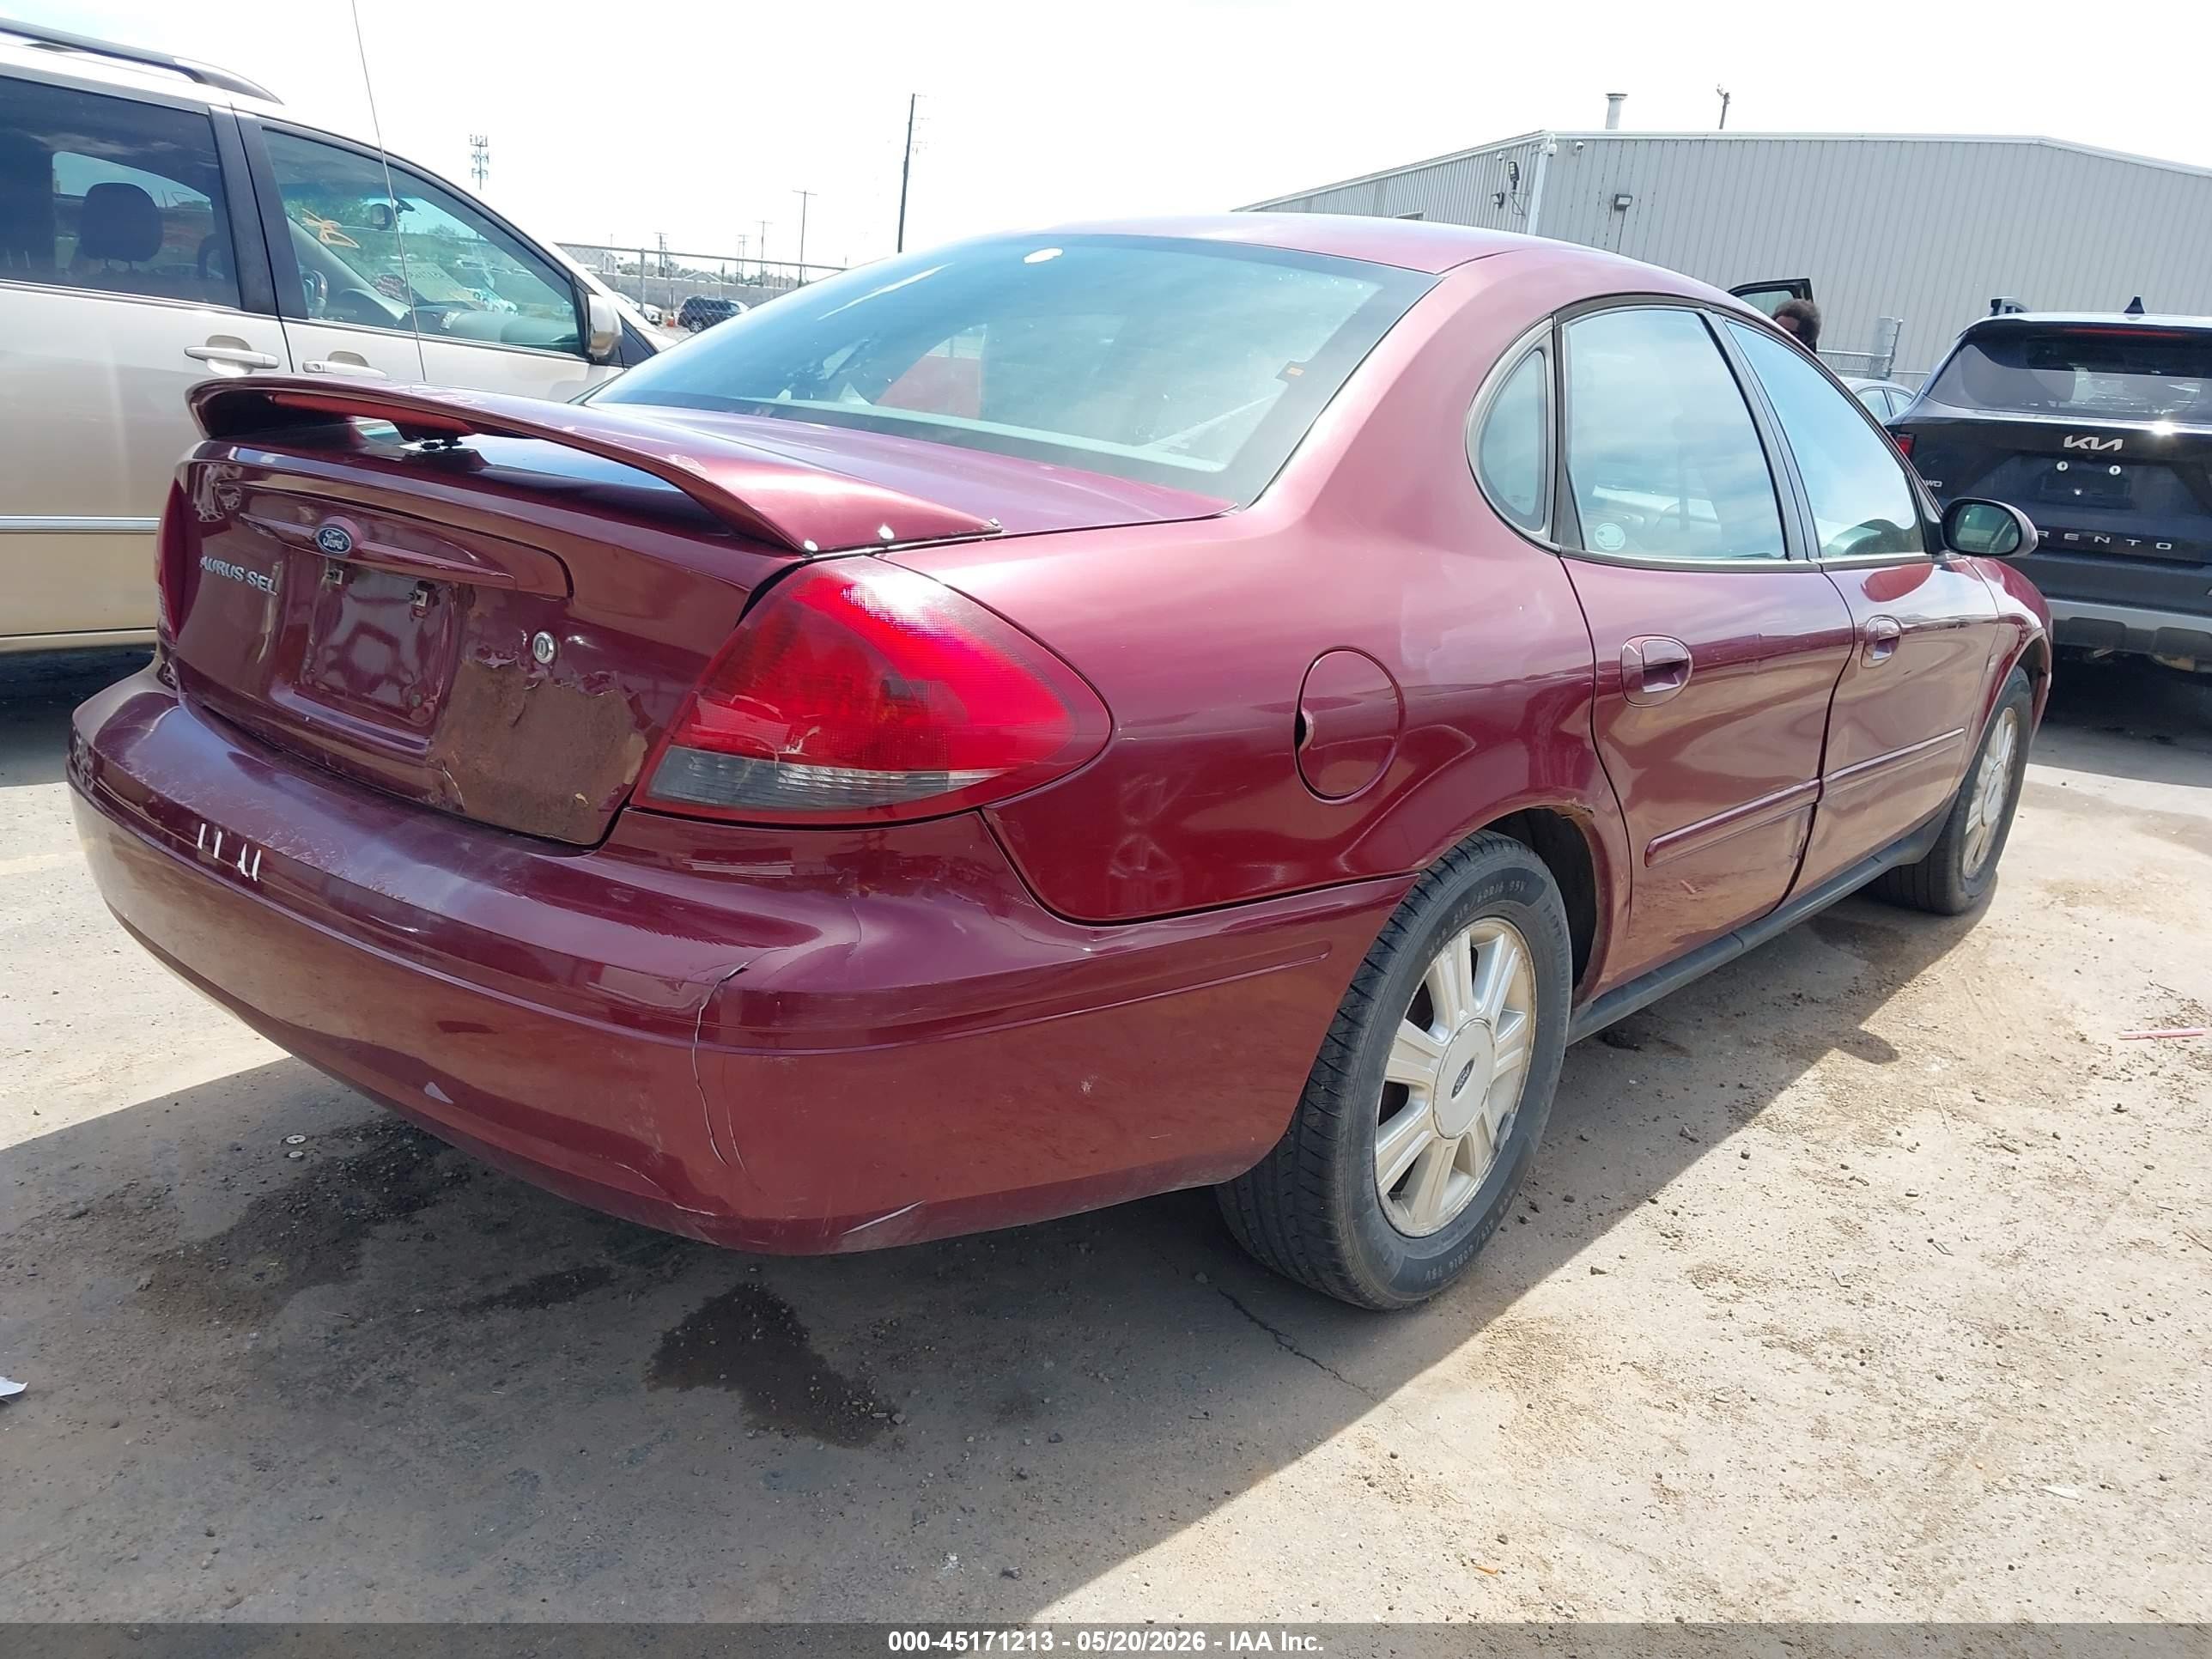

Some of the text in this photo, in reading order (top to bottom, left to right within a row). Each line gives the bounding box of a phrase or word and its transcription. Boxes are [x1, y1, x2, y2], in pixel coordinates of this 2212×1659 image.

[2063, 435, 2124, 452] KIA
[321, 529, 347, 551] Ford
[246, 570, 277, 596] SEL
